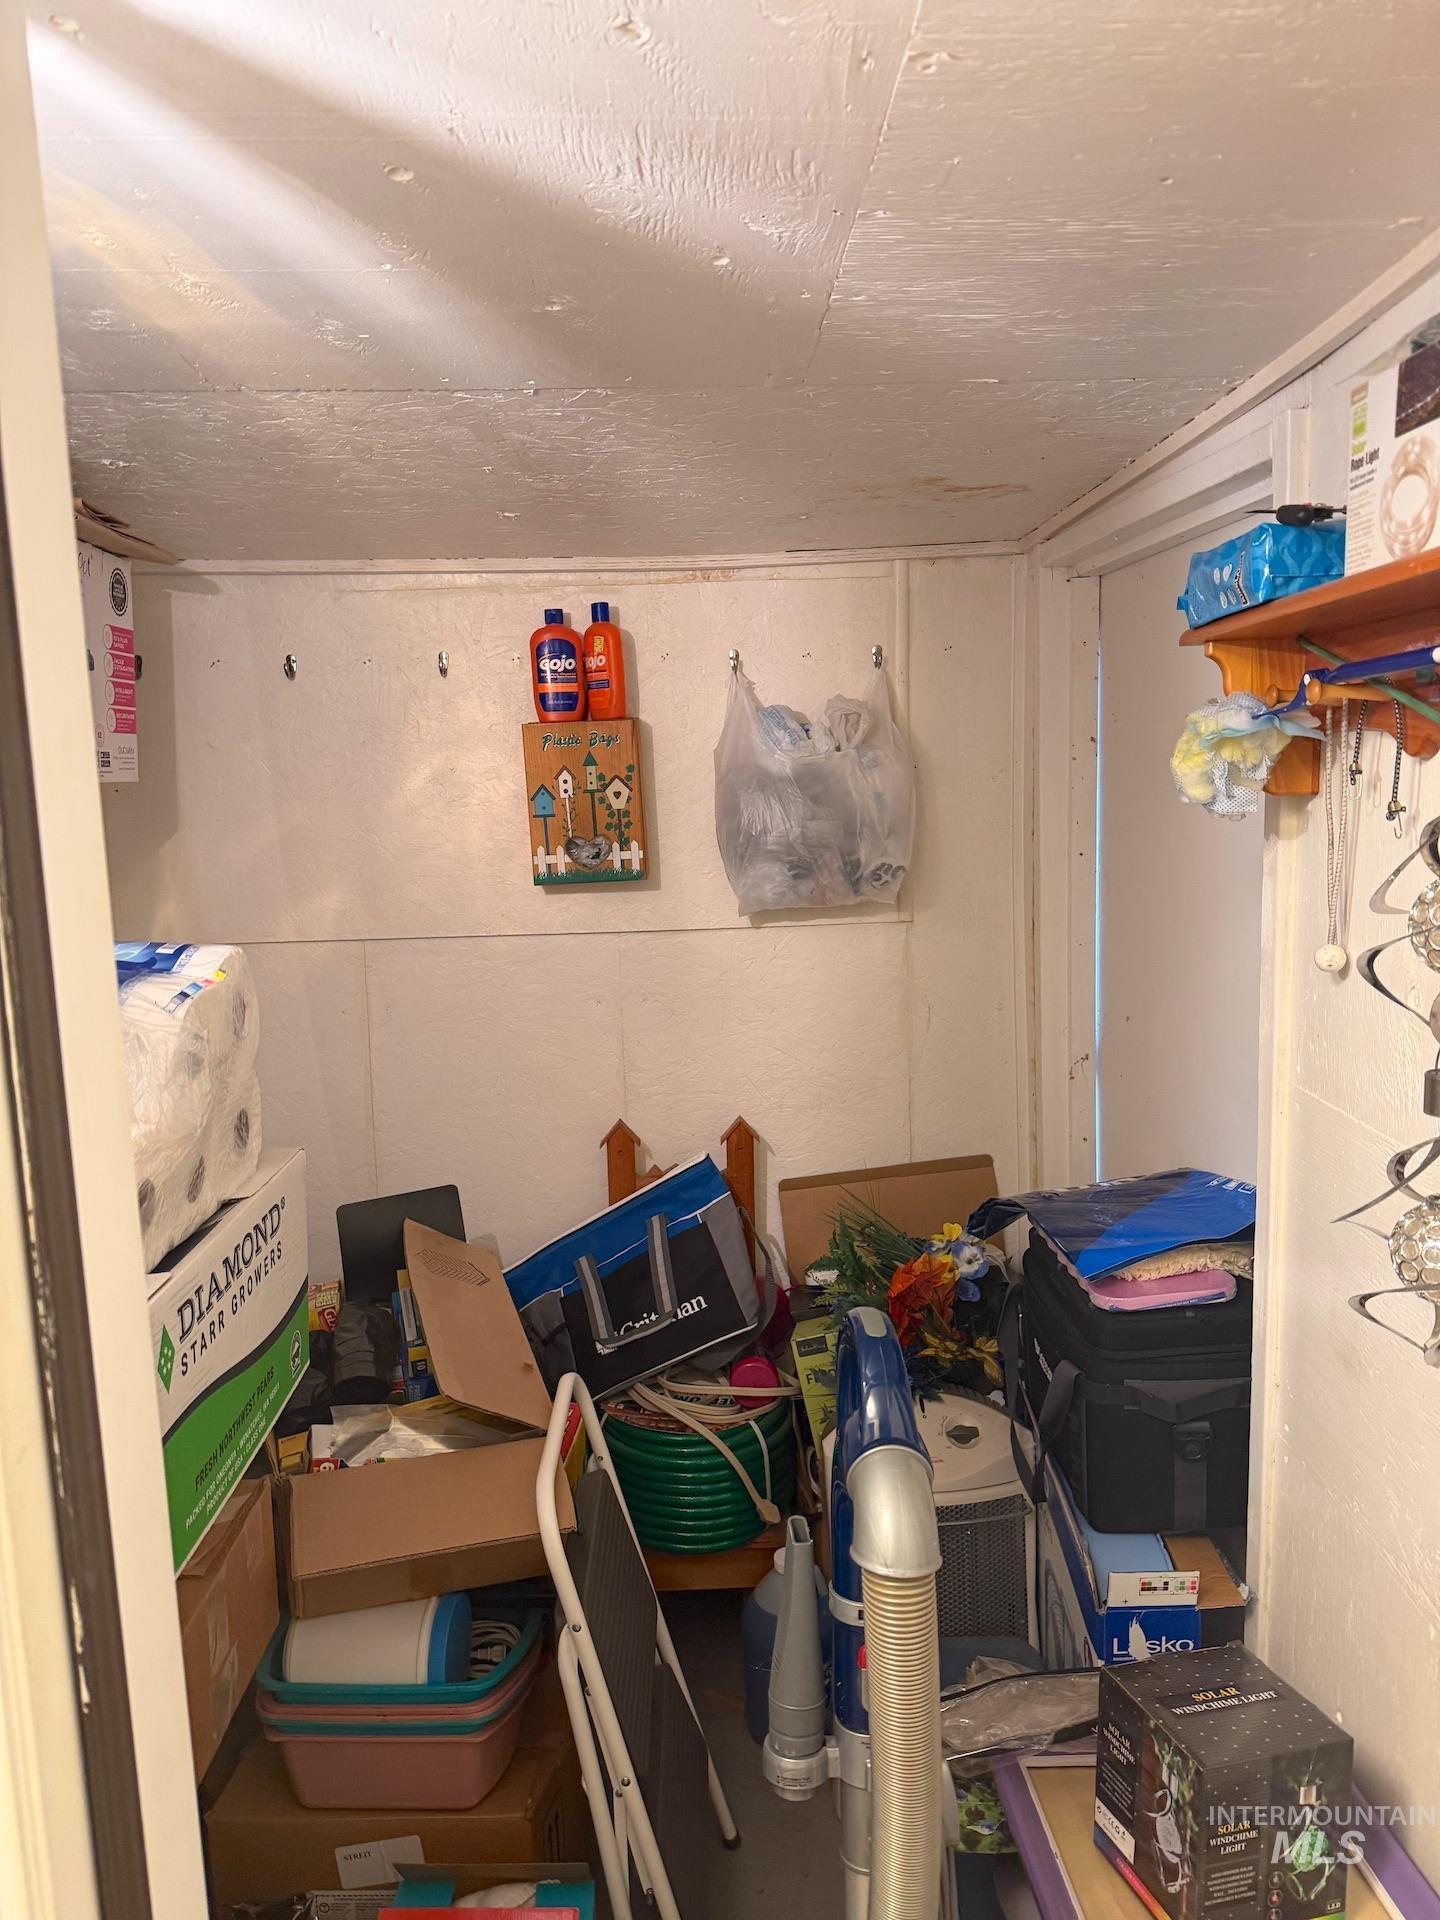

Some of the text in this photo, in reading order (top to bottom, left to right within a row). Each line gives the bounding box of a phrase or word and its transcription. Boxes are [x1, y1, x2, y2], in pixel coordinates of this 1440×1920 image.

[1365, 447, 1380, 465] Light
[542, 730, 620, 752] Plastic Bags
[177, 1203, 281, 1344] DIAMOND
[181, 1240, 282, 1376] STARR GROWERS
[195, 1366, 275, 1491] FRESH NORTHWEST PEARS
[1112, 1636, 1194, 1655] Lsko
[1171, 1690, 1278, 1715] WINDCHIME LIGHT
[1191, 1686, 1241, 1702] SOLAR
[1107, 1722, 1131, 1749] SOLAR
[1109, 1744, 1128, 1765] LIGHT
[1209, 1830, 1259, 1847] WINDCHIME
[1217, 1820, 1251, 1836] SOLAR
[1220, 1843, 1247, 1855] LIGHT
